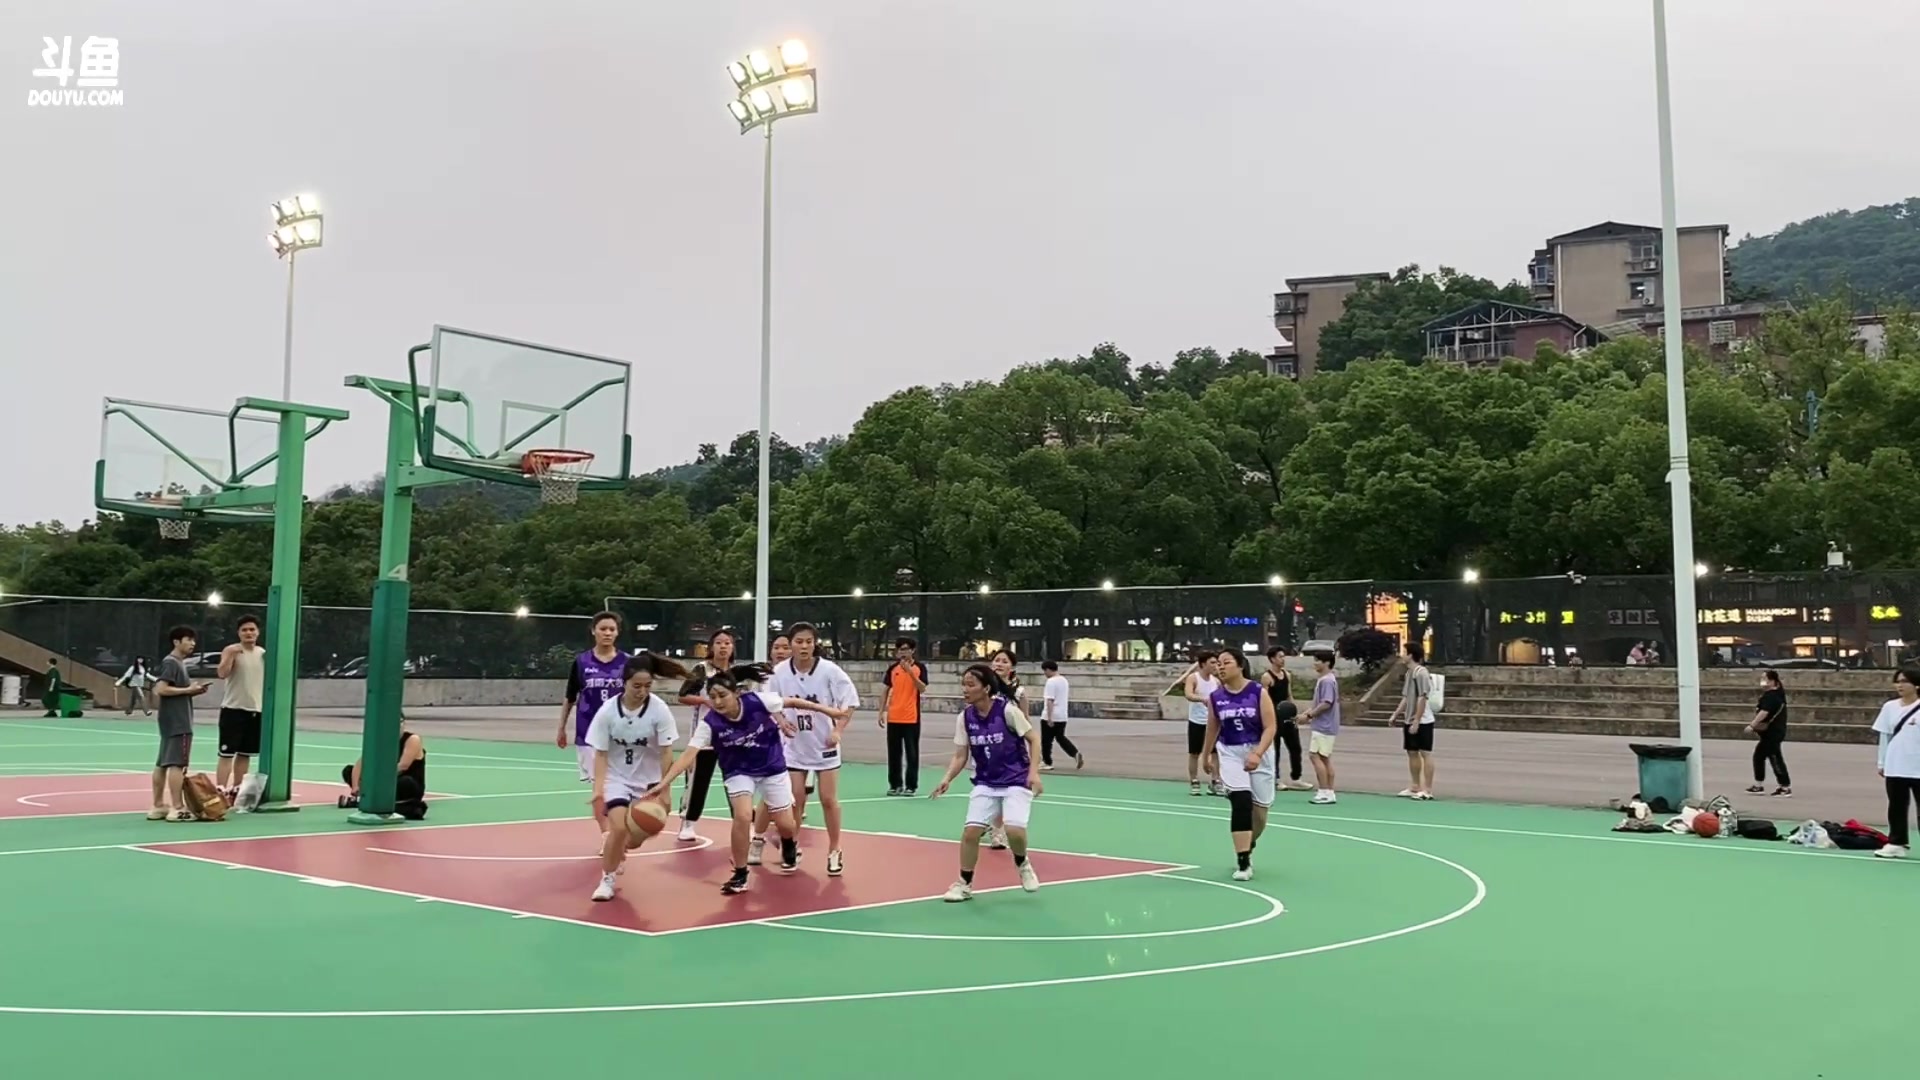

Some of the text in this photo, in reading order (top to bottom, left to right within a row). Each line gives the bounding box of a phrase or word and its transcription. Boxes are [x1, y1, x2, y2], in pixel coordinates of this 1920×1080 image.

[387, 563, 408, 581] 4
[600, 689, 609, 702] 8
[797, 714, 813, 731] 03
[1233, 719, 1244, 731] 5
